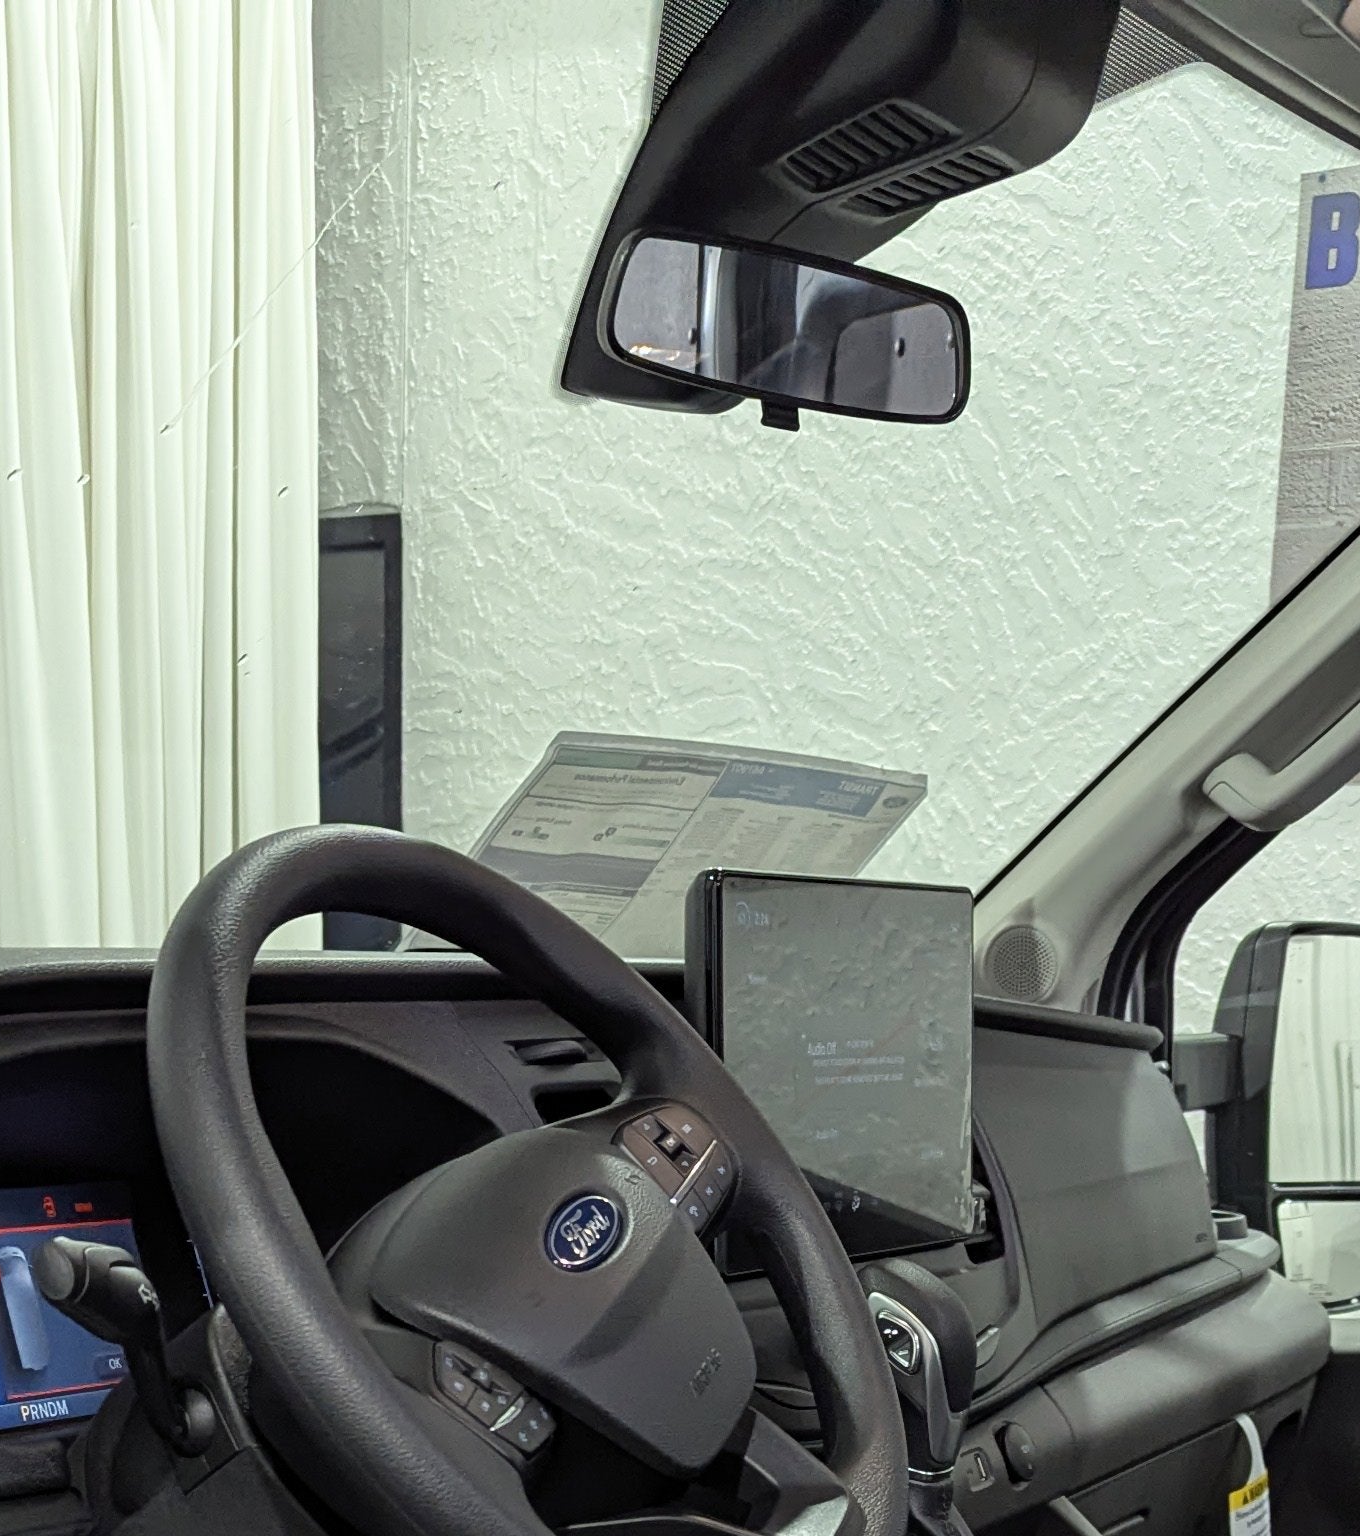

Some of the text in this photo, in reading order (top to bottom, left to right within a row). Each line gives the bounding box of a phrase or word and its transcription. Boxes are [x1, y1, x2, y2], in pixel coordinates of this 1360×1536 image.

[560, 1204, 611, 1258] Ford
[108, 1357, 123, 1370] OK
[20, 1399, 69, 1422] PRNDM
